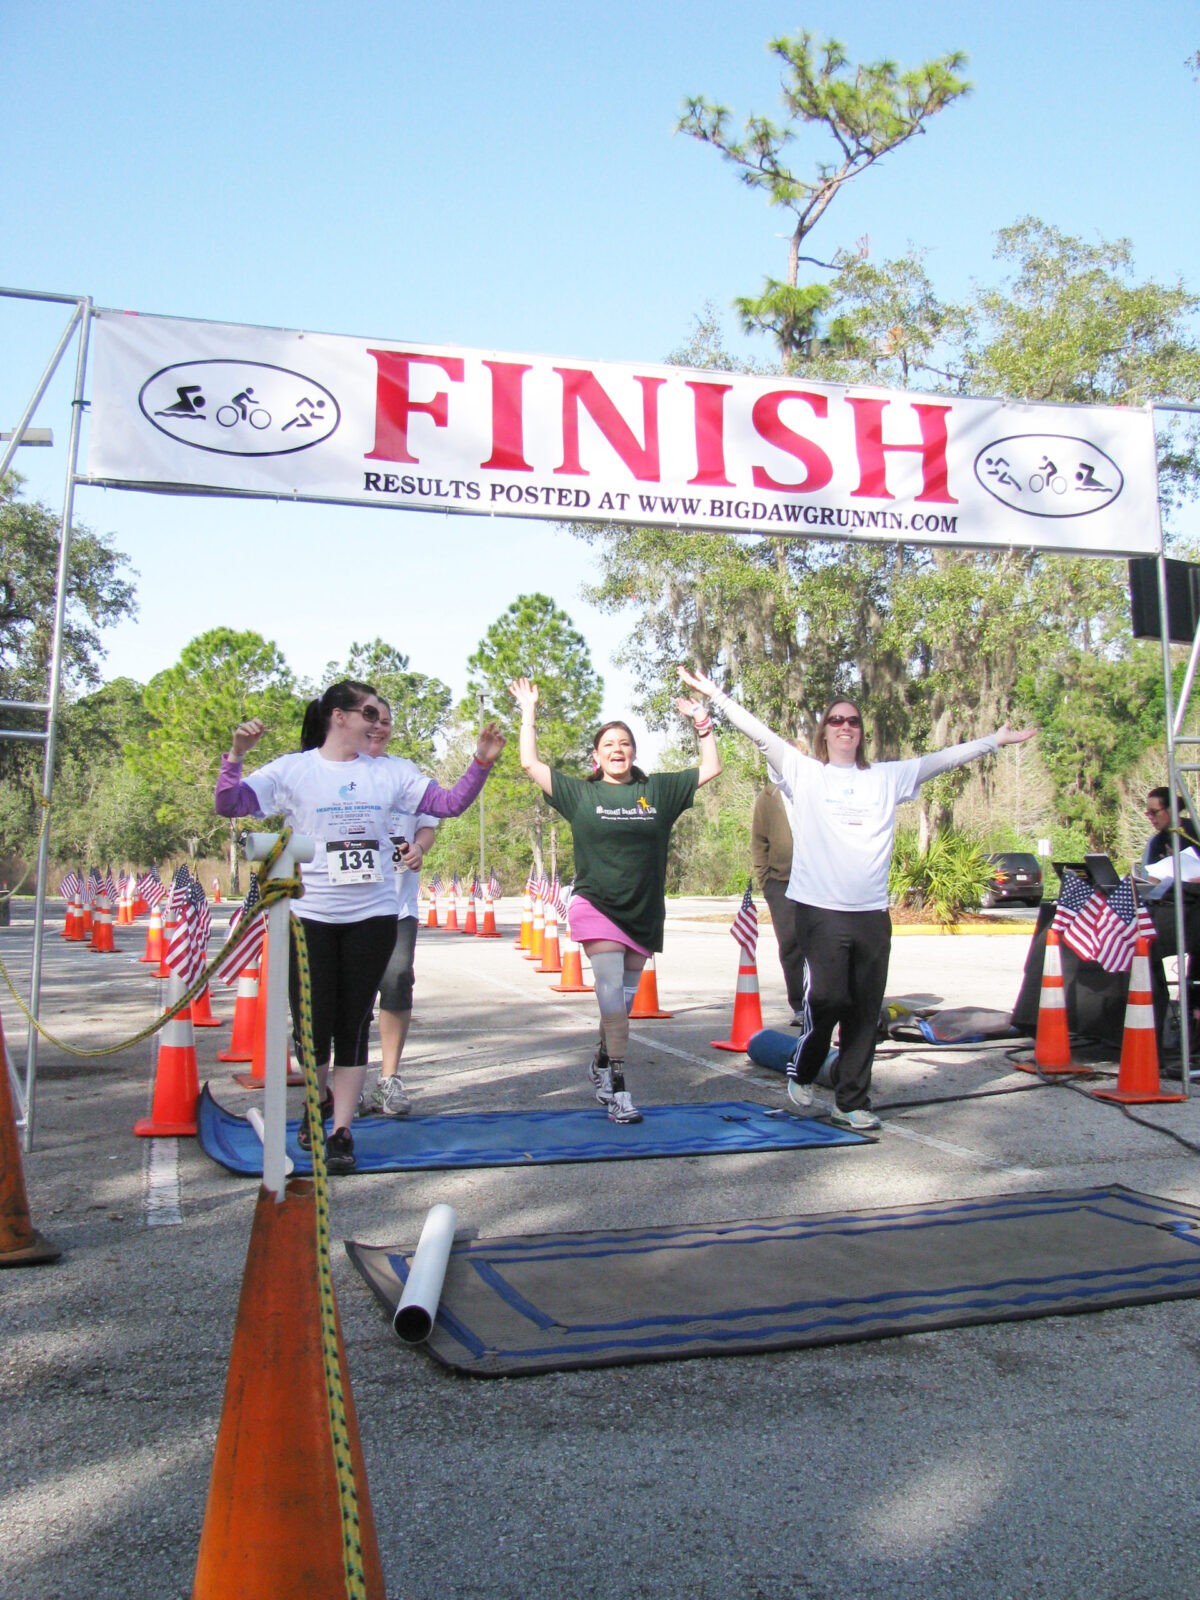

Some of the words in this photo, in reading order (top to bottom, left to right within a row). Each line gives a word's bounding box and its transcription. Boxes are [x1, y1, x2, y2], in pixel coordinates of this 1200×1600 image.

[364, 348, 959, 504] FINISH
[363, 472, 481, 500] RESULTS
[490, 483, 591, 509] POSTED
[598, 491, 630, 512] AT
[638, 494, 959, 534] WWW.BIGDAWGRUNNIN.COM
[339, 850, 375, 871] 134
